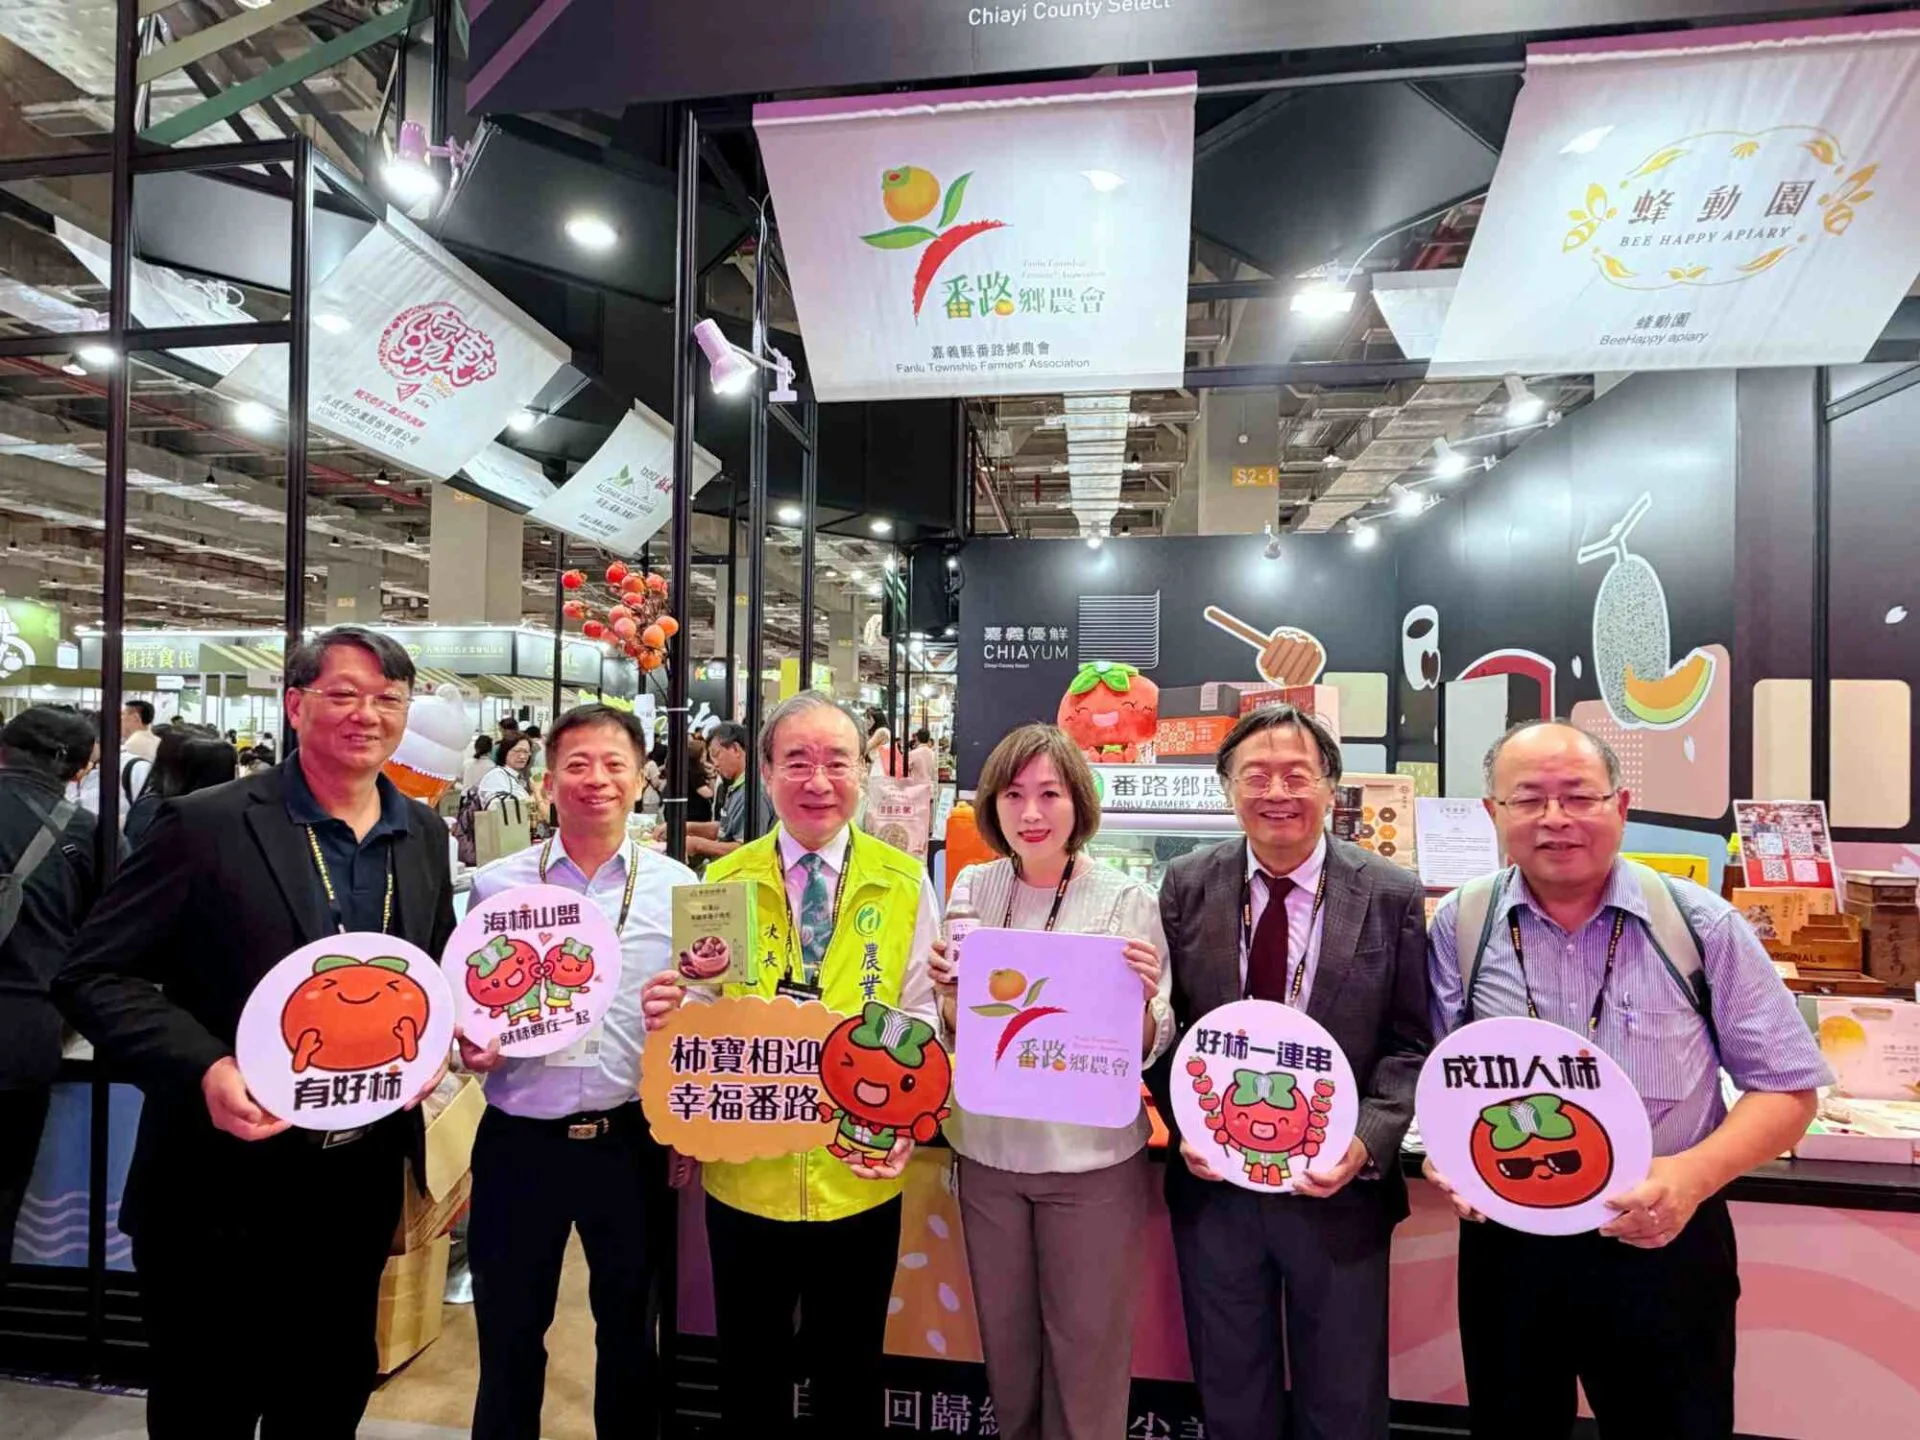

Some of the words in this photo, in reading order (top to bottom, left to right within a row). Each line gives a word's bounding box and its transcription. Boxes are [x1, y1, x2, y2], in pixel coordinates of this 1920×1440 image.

[968, 7, 1027, 26] Chiayi
[1033, 1, 1103, 20] County
[1628, 179, 1816, 225] 蜂動園
[1619, 235, 1652, 247] BEE
[1659, 231, 1718, 246] HAPPY
[1723, 226, 1792, 242] APIARY
[941, 270, 1106, 319] 番路鄉農會
[1634, 311, 1692, 330] 蜂動園
[931, 341, 1051, 360] 嘉義縣番路鄉農會
[1600, 332, 1665, 345] BeeHappy
[1668, 331, 1709, 344] apiary
[896, 363, 925, 374] Fanlu
[929, 361, 978, 373] Township
[980, 360, 1027, 371] Farmers'
[1029, 358, 1090, 369] Association
[1235, 468, 1274, 485] S2-1
[984, 644, 1069, 660] CHIAYUM
[1111, 800, 1143, 809] FANLU
[1146, 800, 1194, 809] FARMERS'
[483, 903, 581, 935] 海柿山盟
[500, 1010, 591, 1047] 就柿要在一起
[671, 1036, 821, 1074] 柿寶相迎
[1017, 1037, 1129, 1077] 番路鄉農會
[1196, 1028, 1332, 1072] 好柿一連串
[1442, 1052, 1601, 1090] 成功人柿
[293, 1068, 403, 1111] 有好柿
[670, 1083, 819, 1121] 幸福番路
